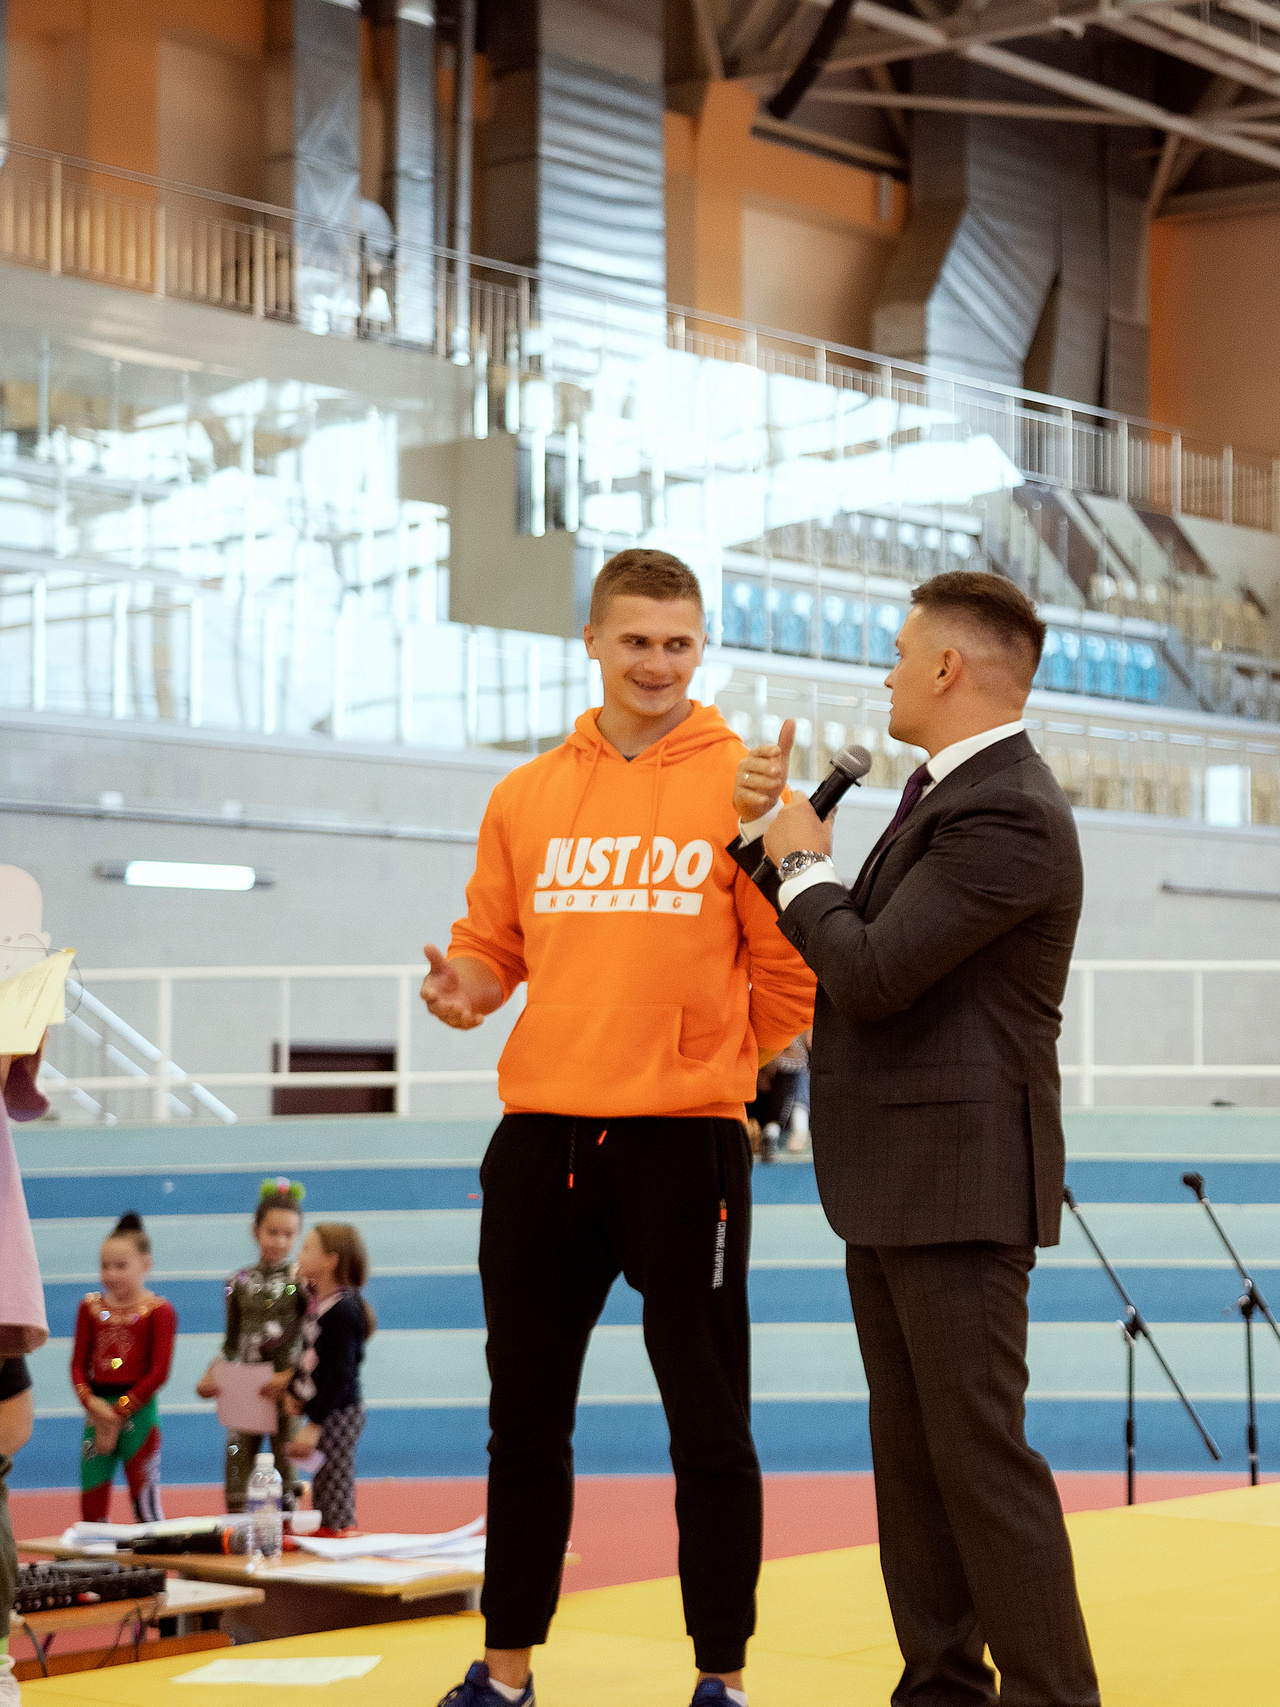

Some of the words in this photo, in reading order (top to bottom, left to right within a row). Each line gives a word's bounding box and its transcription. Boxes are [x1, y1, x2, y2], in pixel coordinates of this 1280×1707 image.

[536, 836, 642, 888] JUST
[638, 836, 713, 888] DO
[550, 894, 683, 909] NOTHING
